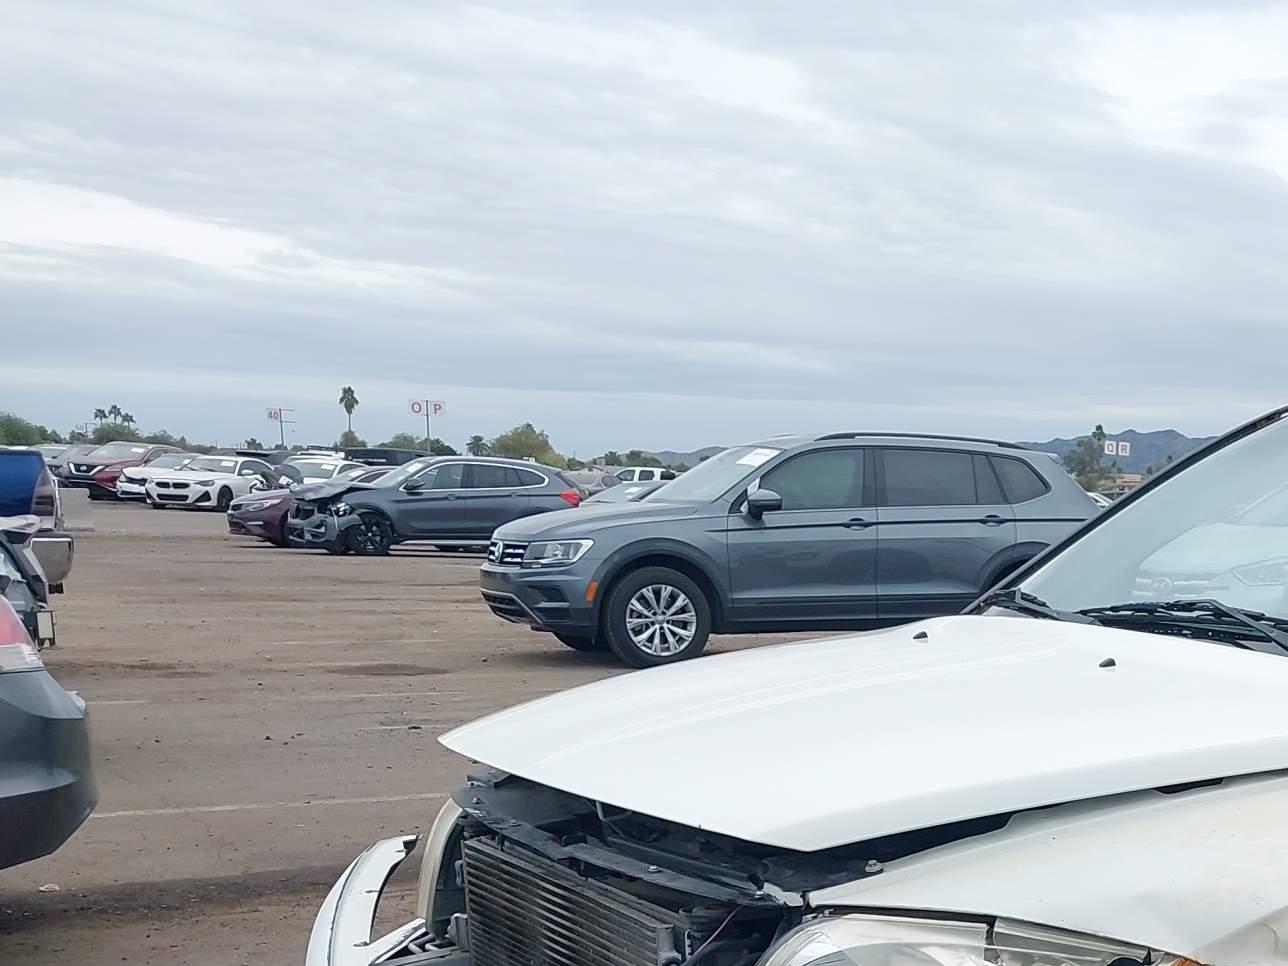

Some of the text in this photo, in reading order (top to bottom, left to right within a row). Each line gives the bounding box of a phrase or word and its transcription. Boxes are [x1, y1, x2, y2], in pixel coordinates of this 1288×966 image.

[411, 402, 442, 415] O P
[267, 411, 279, 420] 40
